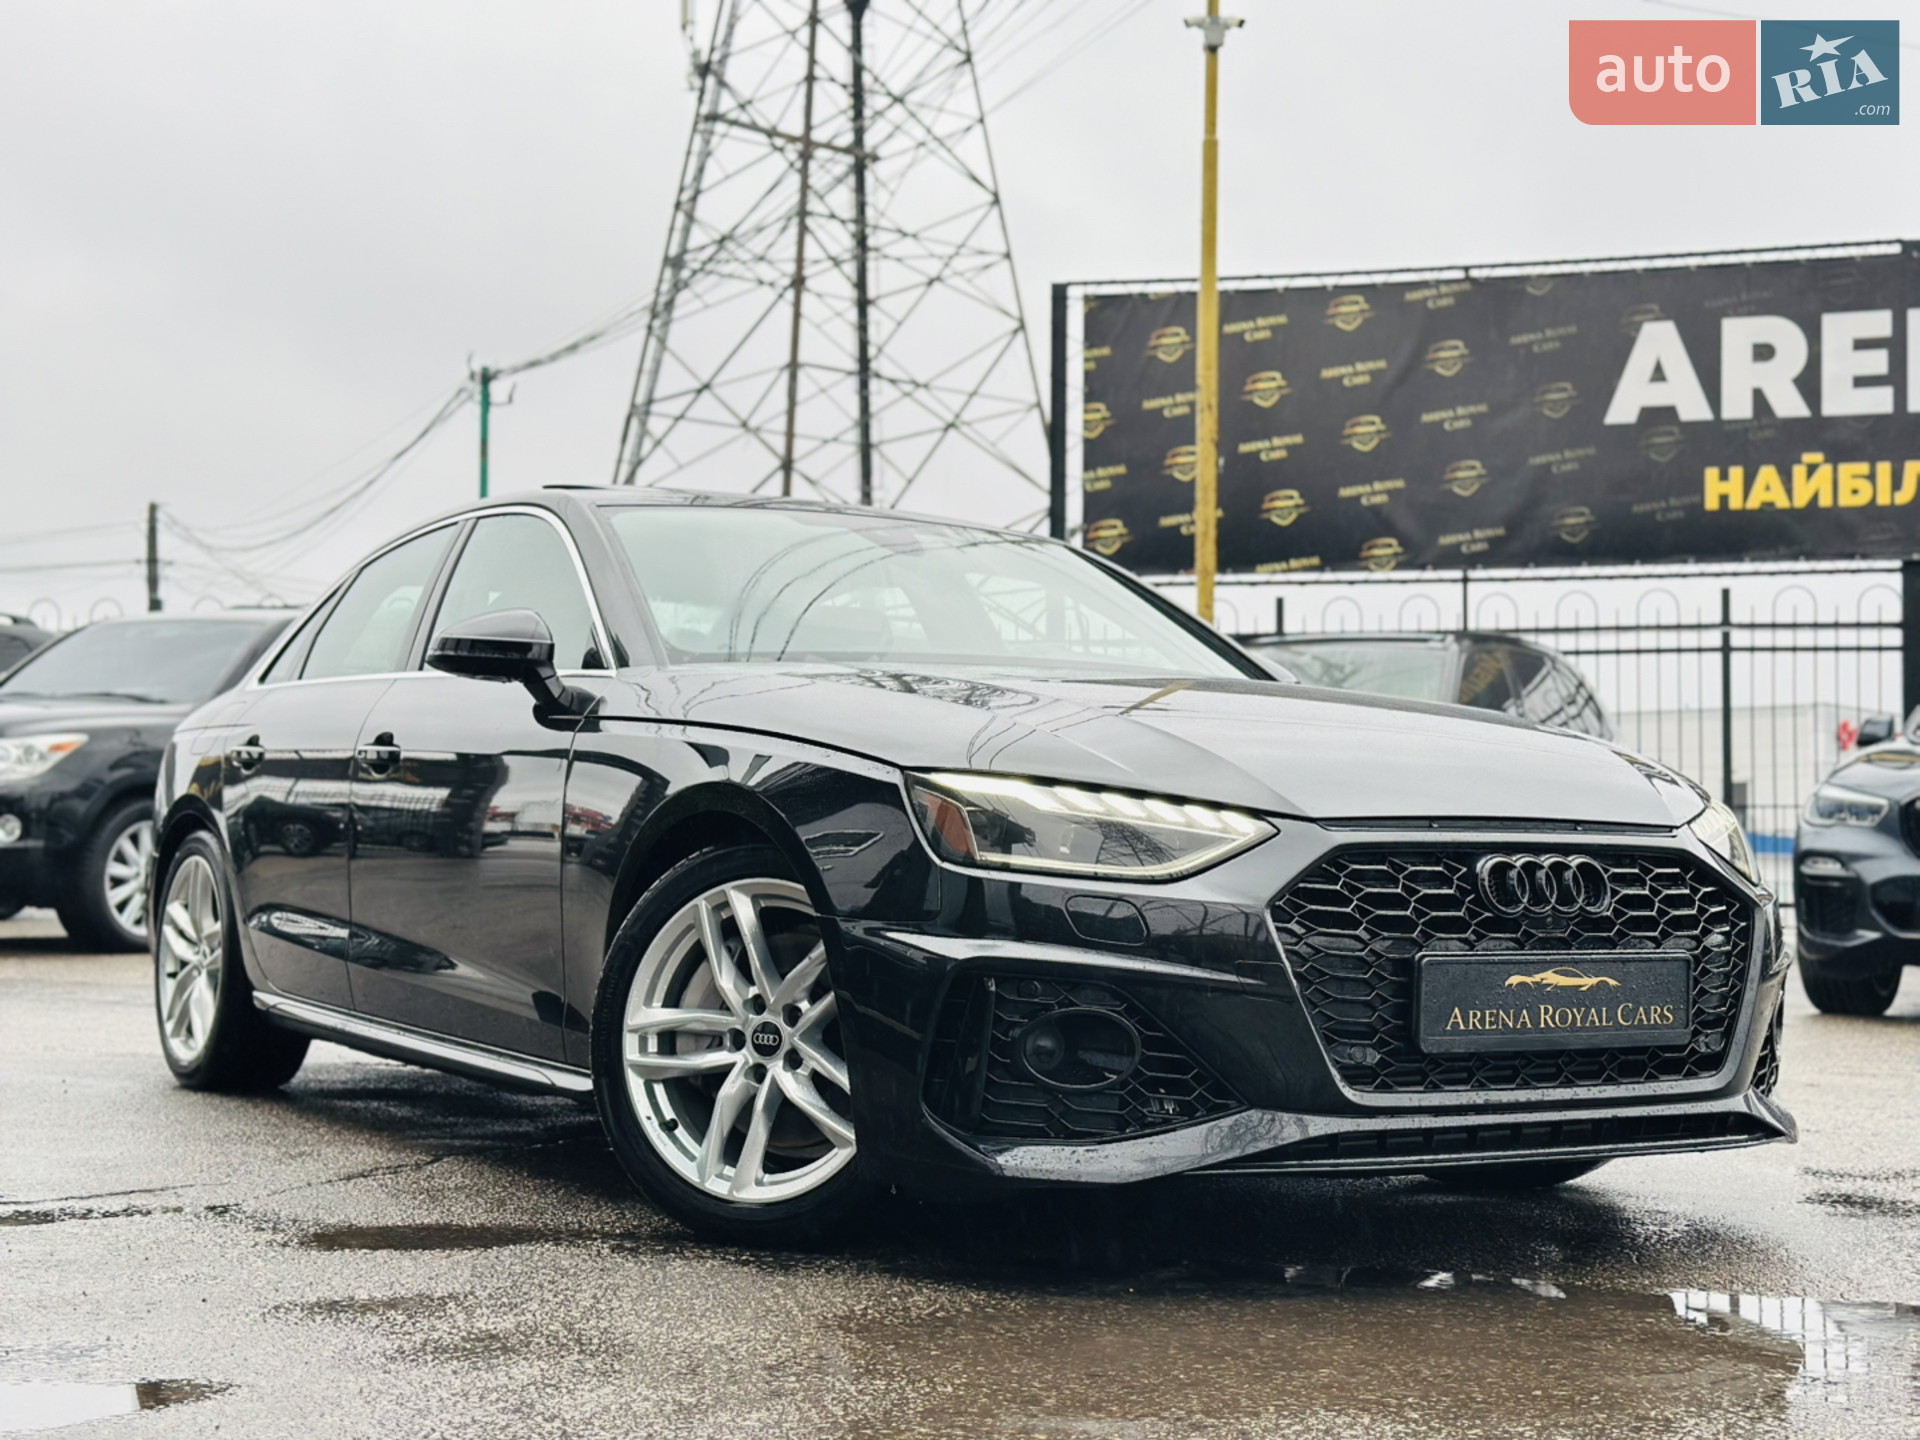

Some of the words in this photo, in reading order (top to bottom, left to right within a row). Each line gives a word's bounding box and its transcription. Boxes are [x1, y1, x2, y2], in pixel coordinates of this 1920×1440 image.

[1603, 308, 1920, 426] ARE
[1446, 1007, 1532, 1030] ARENA
[1539, 1004, 1613, 1028] ROYAL
[1617, 1003, 1674, 1026] CARS
